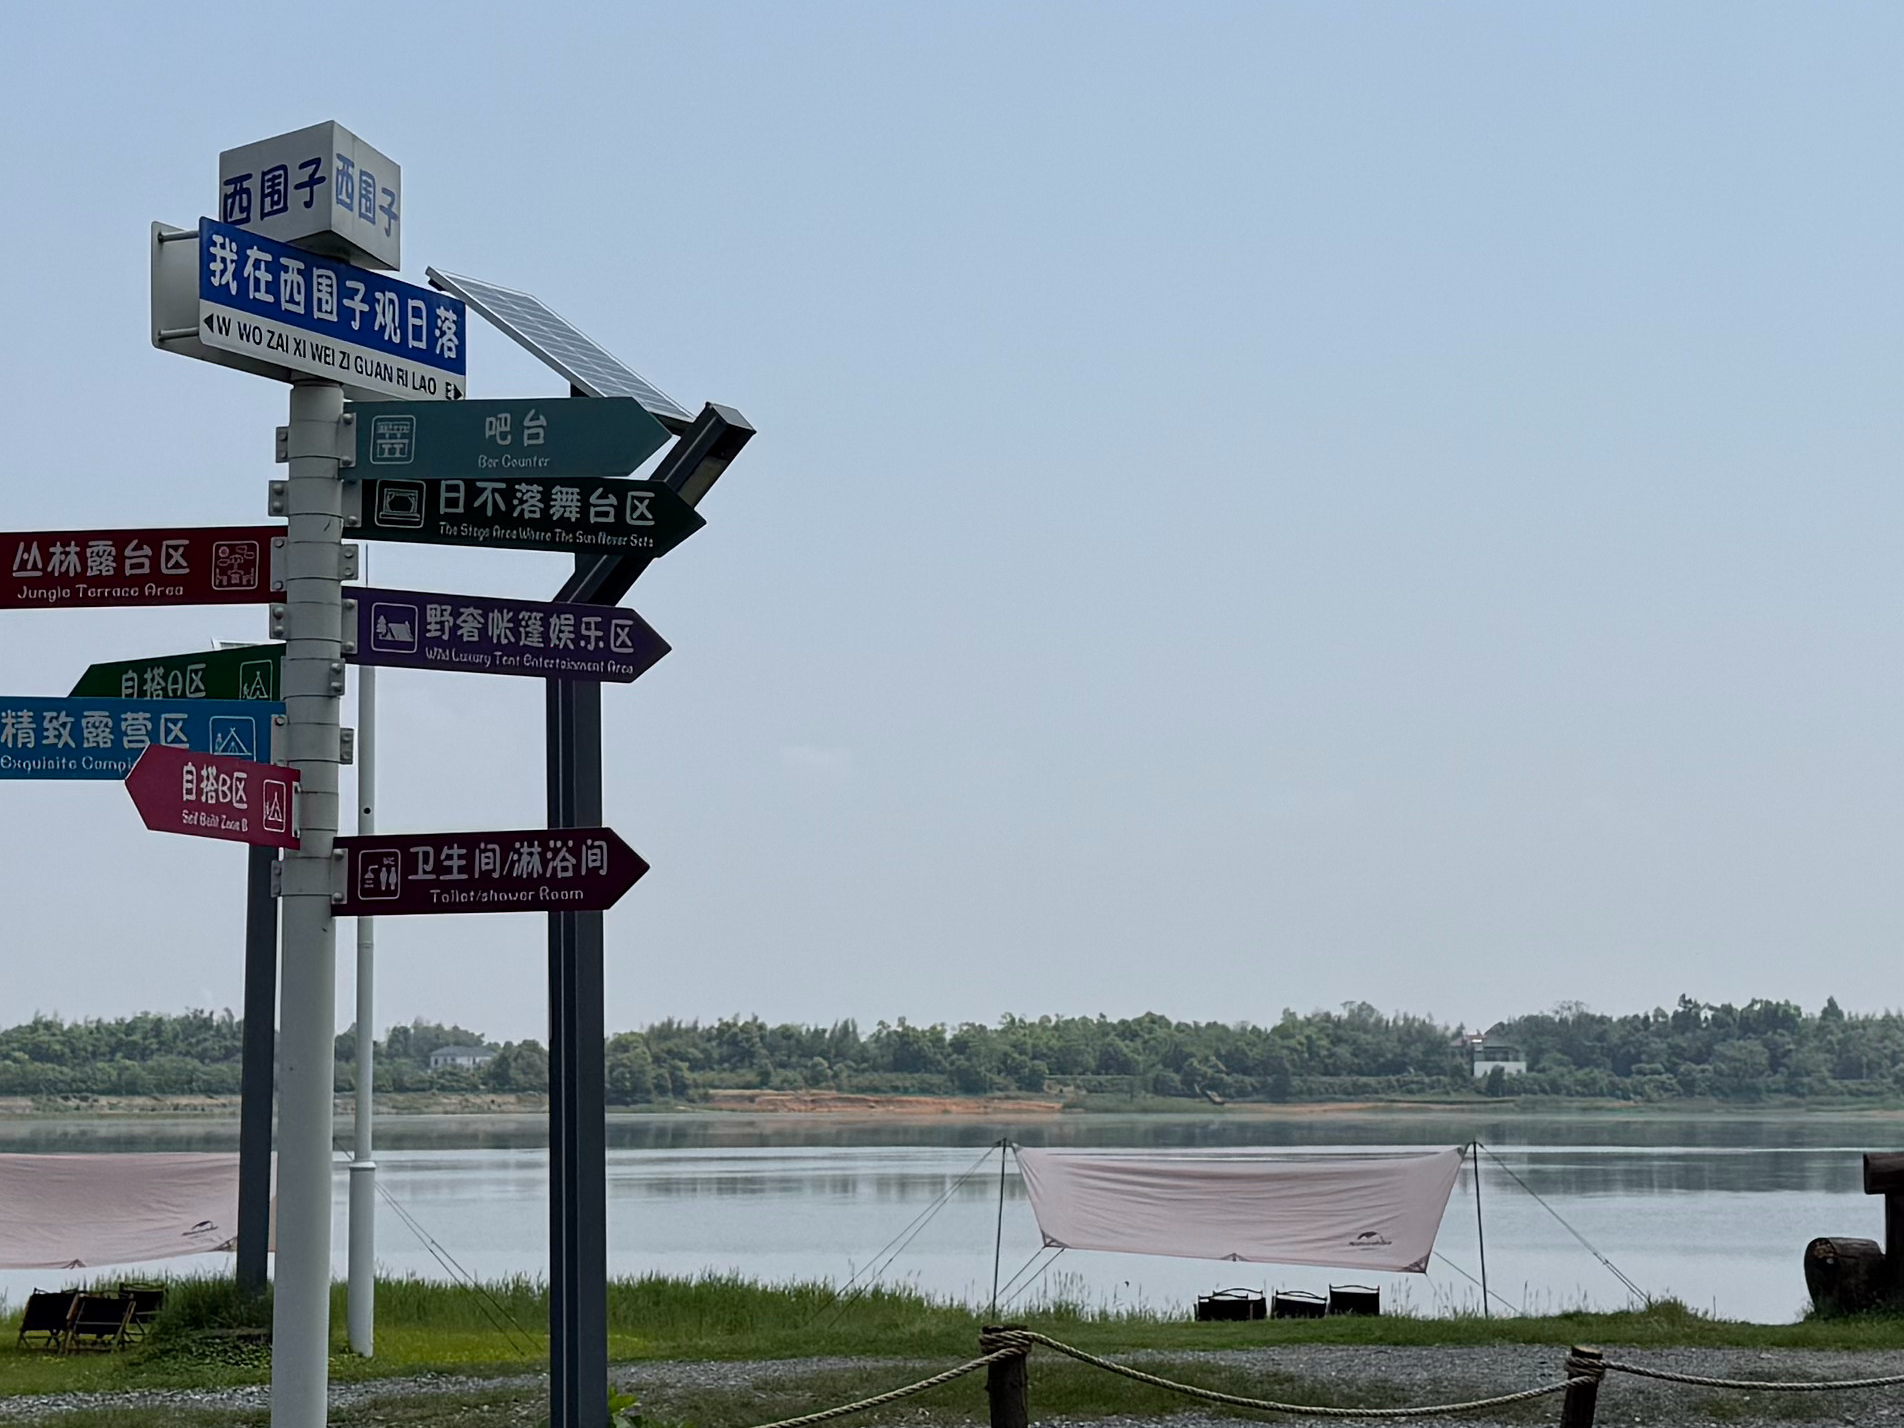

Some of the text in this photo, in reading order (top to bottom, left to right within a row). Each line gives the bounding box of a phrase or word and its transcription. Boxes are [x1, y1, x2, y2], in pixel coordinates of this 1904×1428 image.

[222, 156, 327, 226] 西围子
[335, 152, 399, 238] 西围子
[209, 233, 459, 359] 我在西围子观日落
[217, 315, 231, 337] W
[237, 321, 263, 345] WO
[267, 330, 289, 354] ZAI
[293, 337, 306, 358] XI
[310, 342, 335, 366] WEI
[339, 350, 350, 370] ZI
[355, 355, 393, 383] GUAN
[396, 367, 408, 388] RI
[412, 372, 437, 395] LAO
[485, 408, 547, 446] 吧台
[501, 454, 550, 468] Counter
[440, 480, 655, 526] 日不落舞台区
[439, 522, 457, 535] The
[461, 524, 489, 541] Stage
[493, 525, 517, 539] Area
[519, 527, 552, 541] Where
[554, 529, 573, 543] The
[576, 531, 596, 544] Sun
[630, 534, 654, 548] Sets
[12, 539, 190, 577] 丛林露台区
[17, 583, 183, 603] Jungle Terrace Area
[425, 604, 634, 653] 野奢帐篷娱乐区
[452, 648, 491, 668] Luxury
[494, 651, 520, 666] Tent
[607, 661, 634, 674] Area
[121, 663, 207, 700] 自搭A区
[0, 709, 190, 750] 精致露营区
[0, 754, 77, 773] Exquisite
[182, 762, 248, 809] 自搭B区
[408, 839, 608, 881] 卫生间/淋浴间
[539, 886, 584, 901] Room
